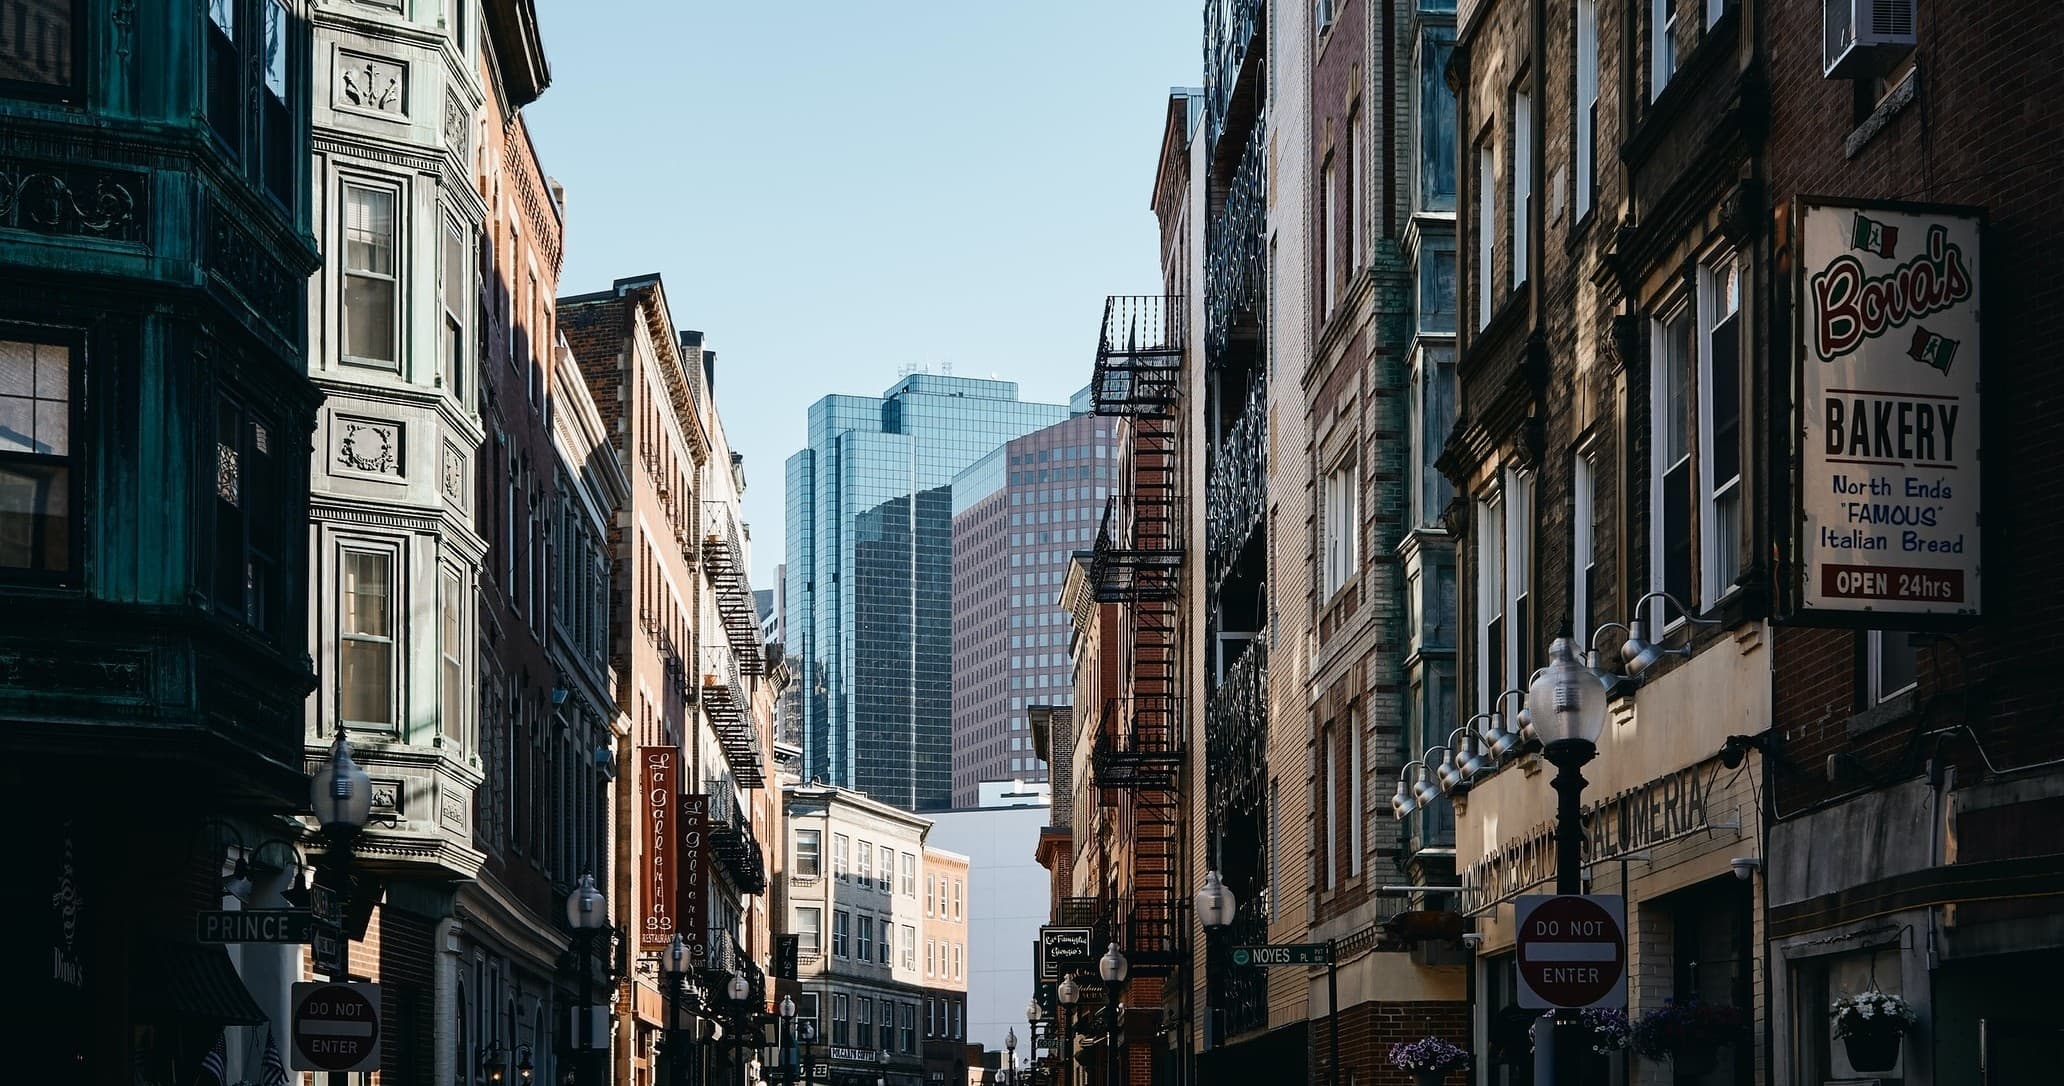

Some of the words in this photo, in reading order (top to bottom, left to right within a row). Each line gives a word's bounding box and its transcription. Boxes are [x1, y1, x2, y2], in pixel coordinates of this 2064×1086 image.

[1811, 224, 1972, 362] Bova's
[1826, 397, 1959, 461] BAKERY
[1832, 475, 1891, 497] North
[1905, 477, 1952, 500] End's
[1841, 502, 1943, 527] "FAMOUS"
[1821, 526, 1888, 551] Italian
[1902, 531, 1963, 555] Bread
[1836, 570, 1888, 596] OPEN
[1899, 573, 1952, 599] 24hrs
[1500, 818, 1558, 897] MERCATO
[1579, 763, 1704, 864] SALUMERIA
[650, 788, 668, 913] Galleria
[207, 916, 289, 940] PRINCE
[641, 933, 675, 944] RESTAURANT
[1536, 920, 1560, 936] DO
[1570, 920, 1605, 936] NOT
[51, 946, 84, 986] Dino's
[1252, 948, 1291, 963] NOYES
[1300, 952, 1309, 963] PL
[1543, 967, 1600, 983] ENTER
[309, 1002, 329, 1016] DO
[335, 1003, 364, 1017] NOT
[311, 1039, 359, 1054] ENTER
